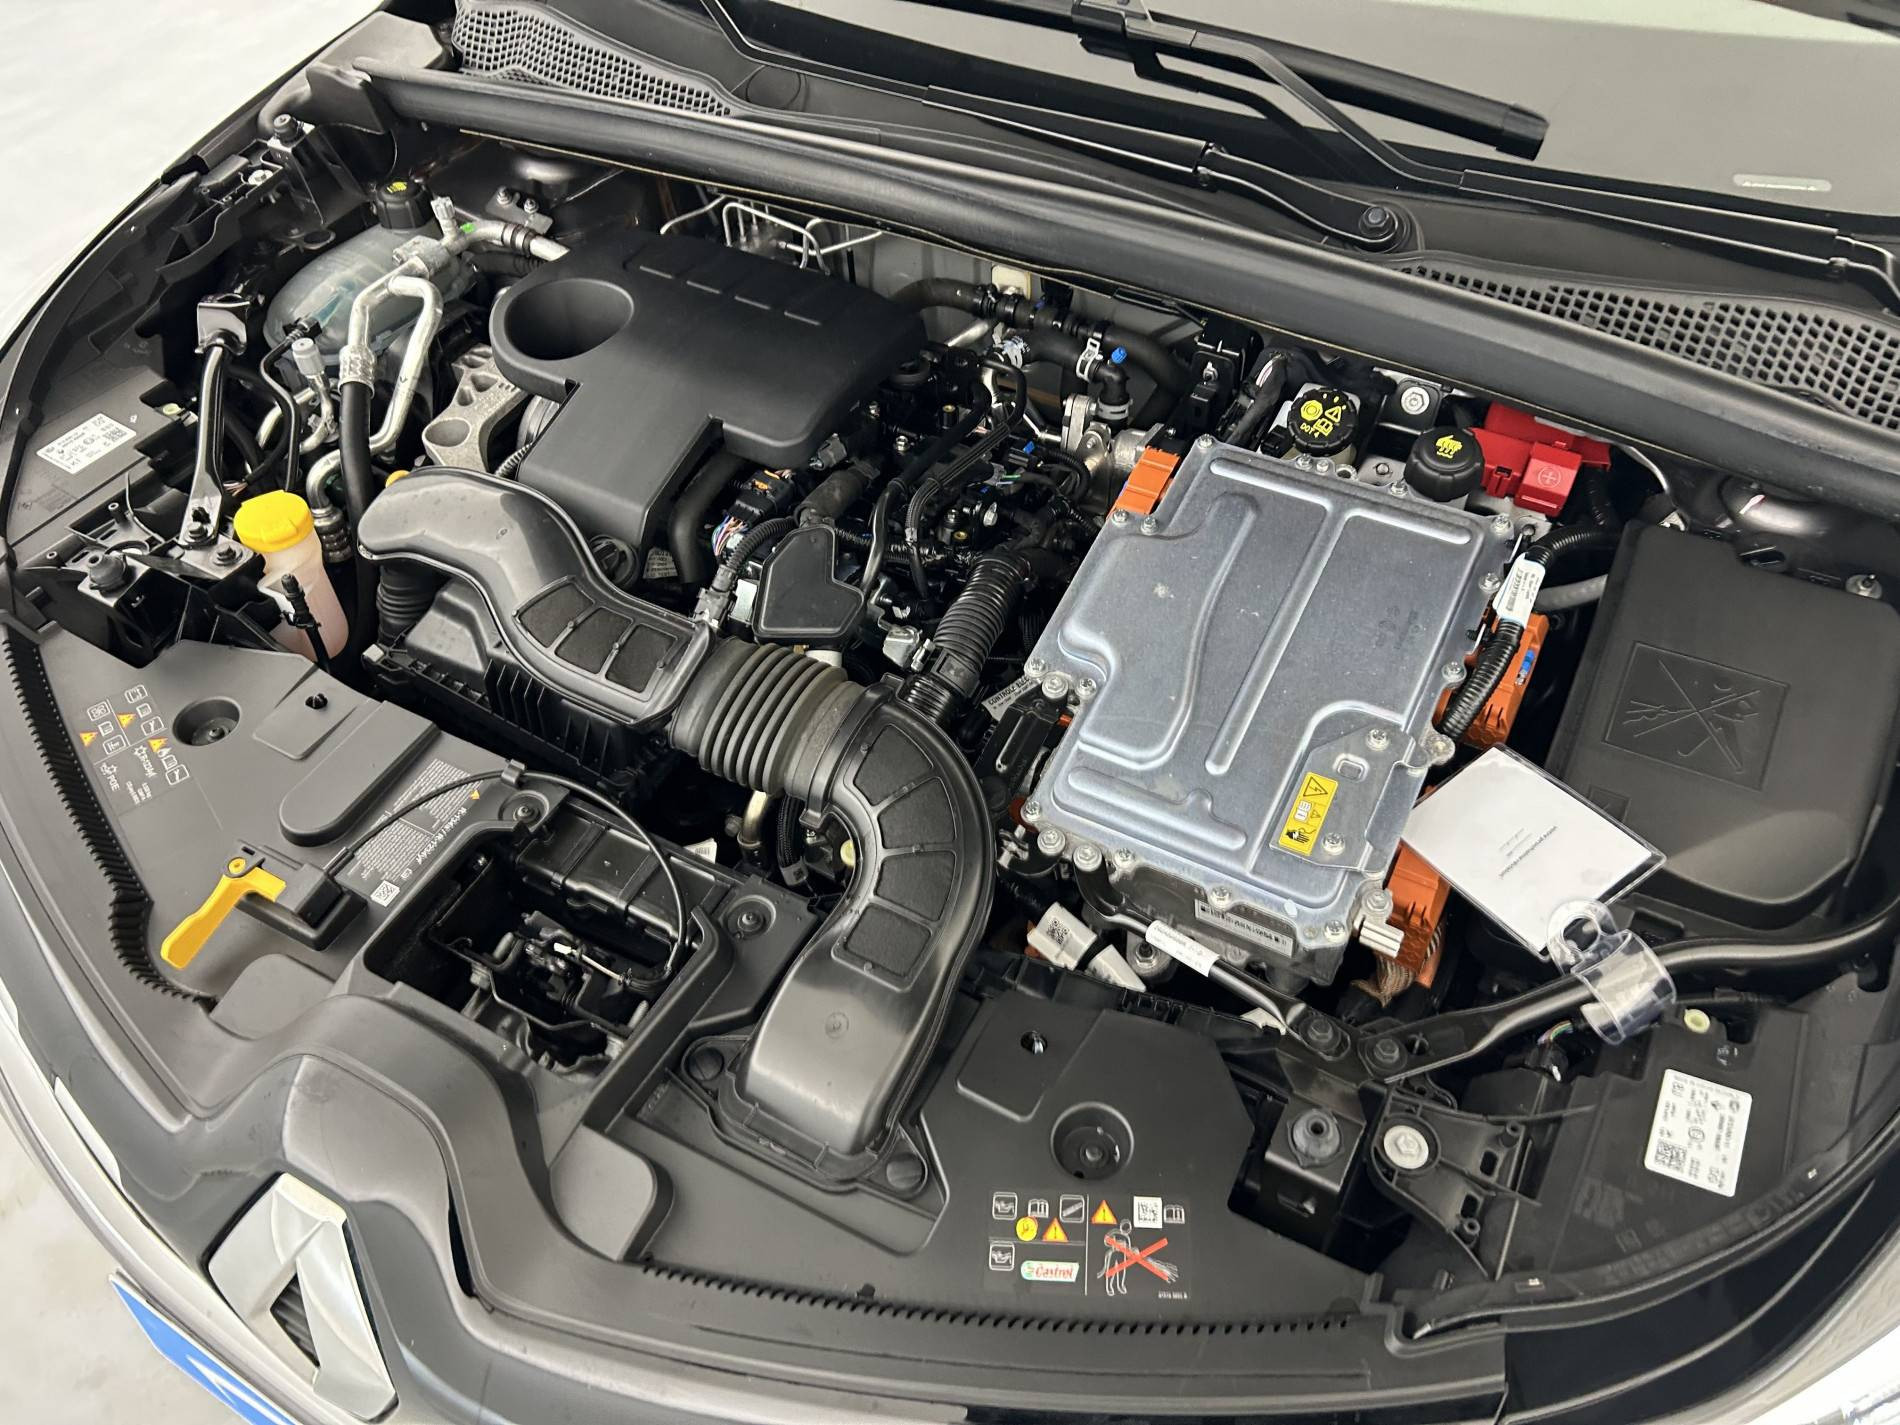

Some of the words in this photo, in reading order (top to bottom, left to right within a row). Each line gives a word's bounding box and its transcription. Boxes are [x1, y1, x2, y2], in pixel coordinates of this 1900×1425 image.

[1300, 422, 1314, 435] DOT
[106, 774, 120, 792] POE
[1035, 1263, 1074, 1279] Castrol
